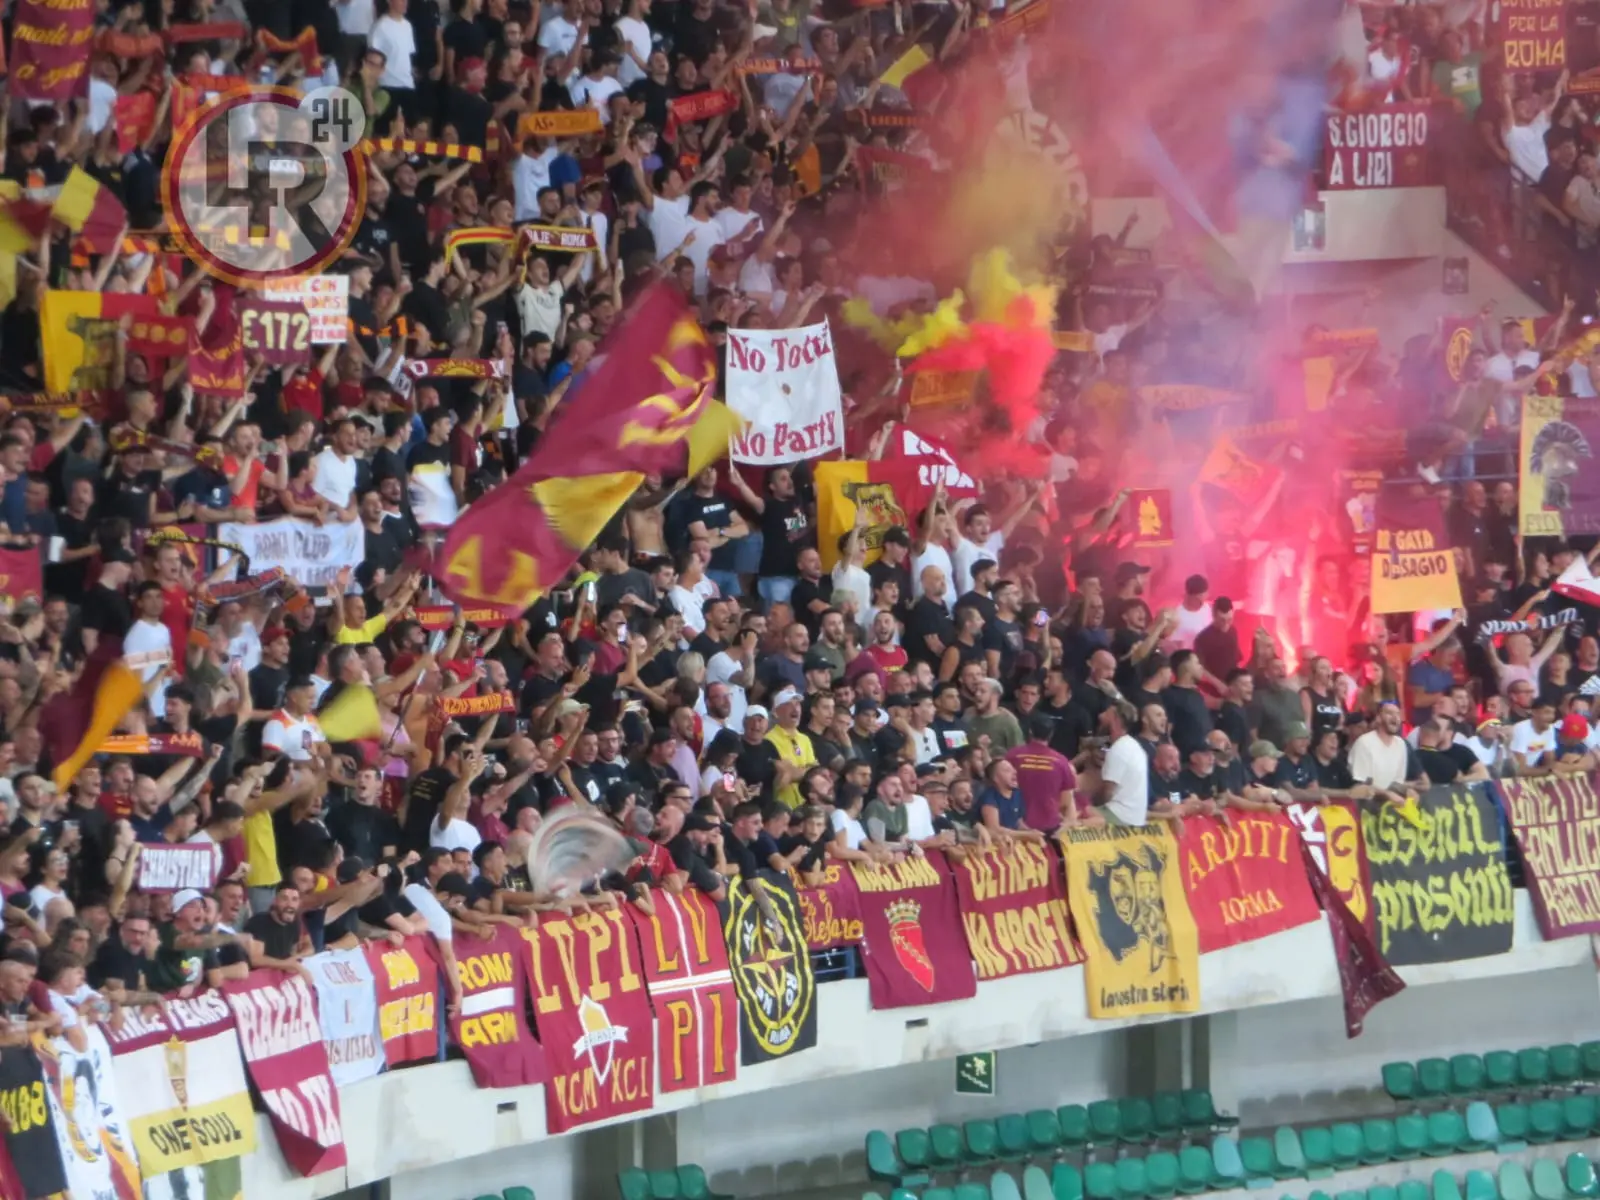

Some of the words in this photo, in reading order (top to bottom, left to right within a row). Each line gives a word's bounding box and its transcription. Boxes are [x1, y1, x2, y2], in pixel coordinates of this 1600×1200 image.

[1504, 37, 1565, 68] ROMA
[1329, 152, 1344, 185] A
[729, 333, 766, 373] No
[1188, 820, 1291, 890] ARDITI
[520, 907, 641, 1015] LVPI
[148, 1118, 192, 1156] ONE
[189, 1111, 243, 1148] SOUL
